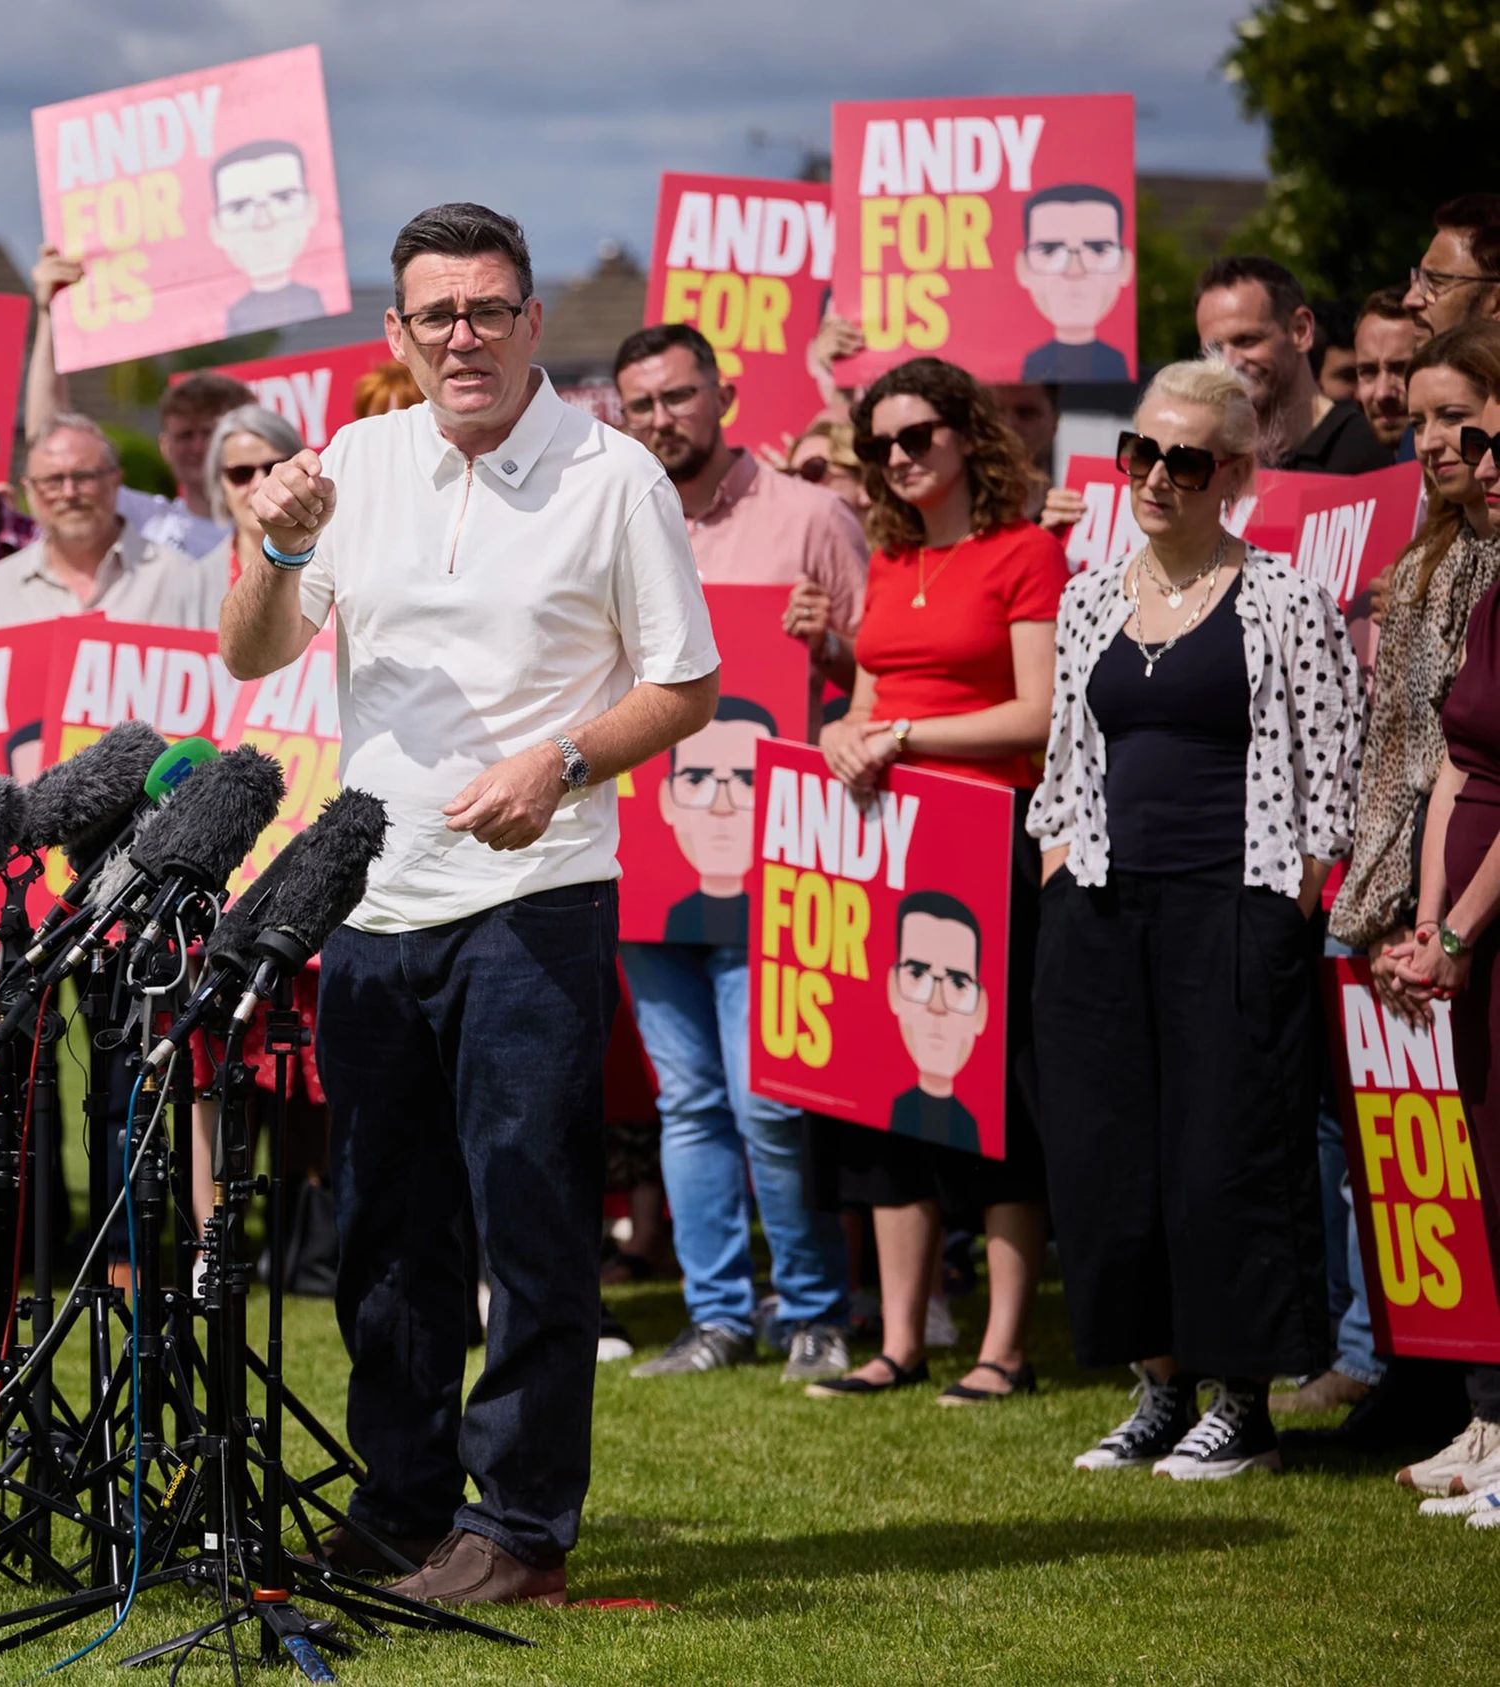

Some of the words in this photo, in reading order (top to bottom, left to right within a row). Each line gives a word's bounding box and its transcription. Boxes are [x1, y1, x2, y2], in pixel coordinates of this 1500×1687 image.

[57, 85, 220, 190] ANDY
[858, 115, 1046, 196] ANDY
[61, 169, 186, 261] FOR
[666, 191, 837, 280] ANDY
[861, 194, 993, 273] FOR
[70, 250, 155, 331] US
[662, 268, 792, 354] FOR
[861, 272, 951, 352] US
[1297, 498, 1376, 602] ANDY
[61, 638, 242, 741] ANDY
[762, 766, 920, 891] ANDY
[761, 862, 871, 981] FOR
[760, 959, 834, 1068] US
[1354, 1092, 1482, 1200] FOR
[1371, 1202, 1463, 1310] US
